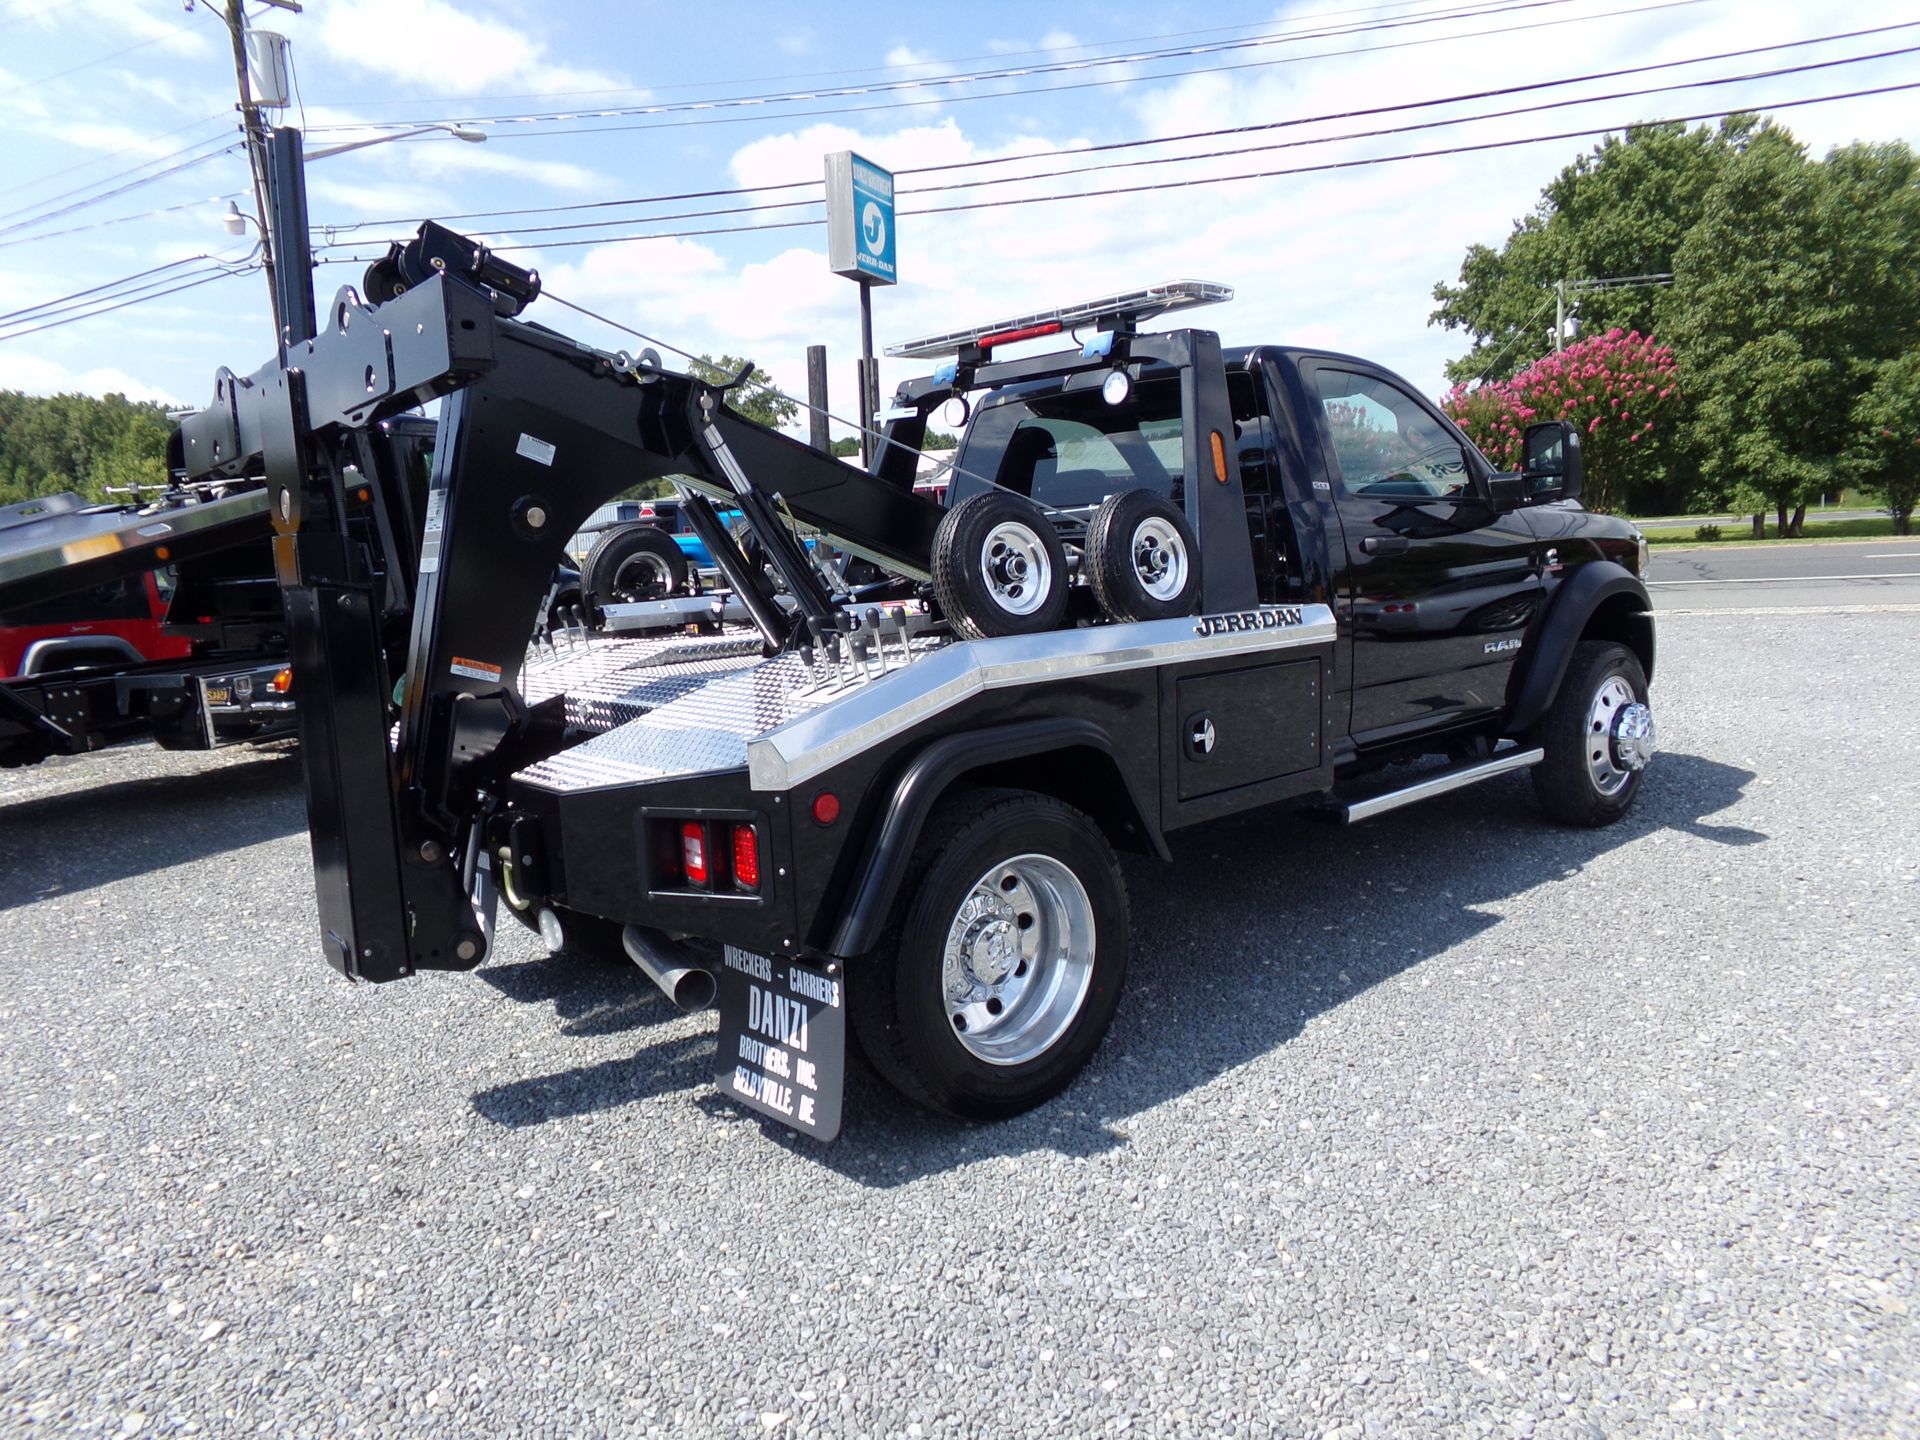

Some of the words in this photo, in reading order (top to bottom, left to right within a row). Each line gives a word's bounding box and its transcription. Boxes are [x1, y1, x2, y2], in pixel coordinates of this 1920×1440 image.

[865, 215, 881, 243] J
[857, 253, 894, 273] JERR-DAN
[1195, 607, 1303, 637] JERR-DAN
[1483, 639, 1522, 653] RAM
[724, 943, 772, 983] WRECKERS
[789, 967, 840, 1008] CARRIERS
[748, 984, 808, 1052] DANZI
[738, 1034, 790, 1079] BROTHERS,
[796, 1058, 817, 1091] INC.
[733, 1065, 793, 1116] SELBYVILLE,
